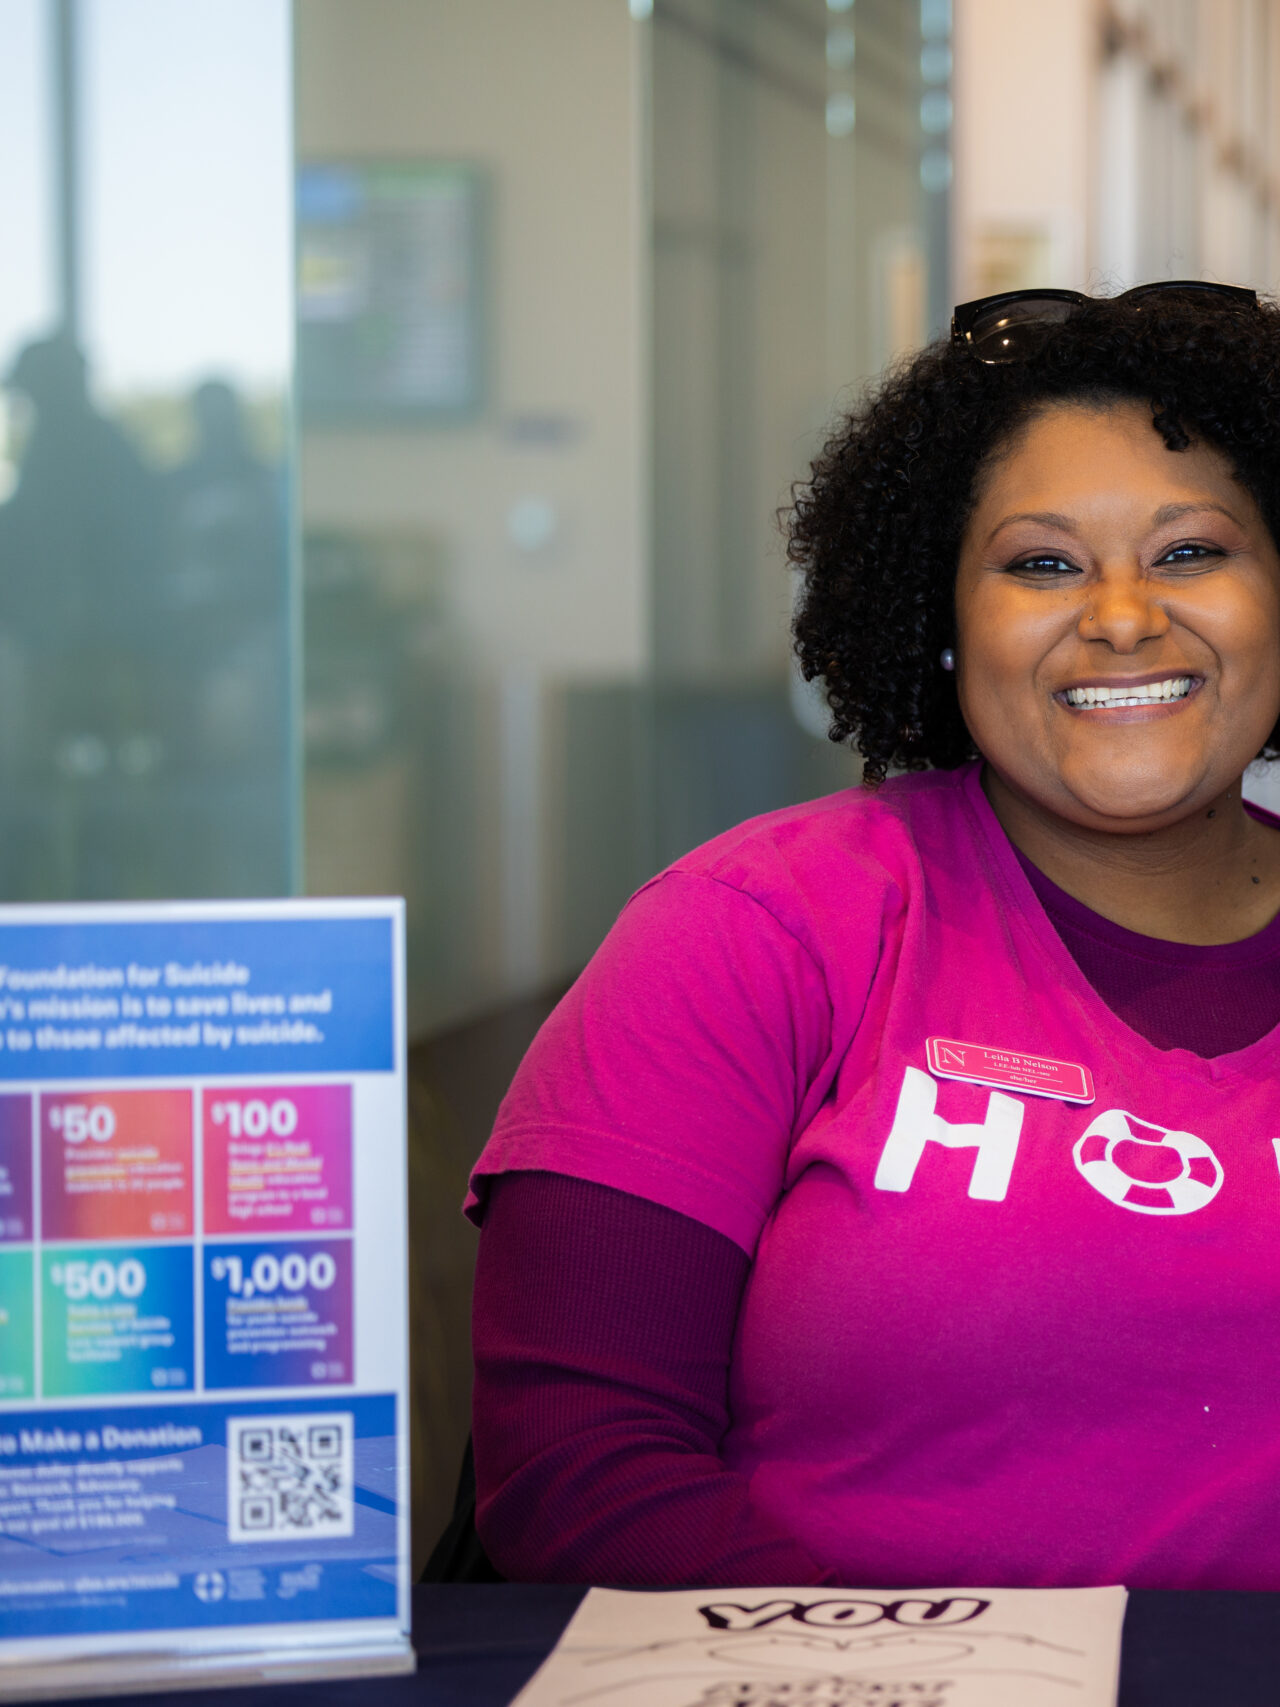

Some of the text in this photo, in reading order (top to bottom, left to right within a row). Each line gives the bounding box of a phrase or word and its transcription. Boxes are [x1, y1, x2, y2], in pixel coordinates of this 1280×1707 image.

[127, 962, 160, 988] for
[164, 961, 249, 987] Suicide
[28, 992, 119, 1019] mission
[121, 992, 144, 1019] is
[147, 992, 172, 1019] to
[175, 998, 229, 1016] save
[231, 991, 286, 1015] lives
[289, 989, 332, 1014] and
[6, 1018, 325, 1050] to those affected by suicide.
[941, 1047, 967, 1068] N
[983, 1051, 1059, 1073] Leila B Nelson
[1009, 1074, 1037, 1085] she/her
[49, 1104, 115, 1143] $50
[211, 1098, 298, 1138] $100
[51, 1258, 146, 1299] $500
[211, 1252, 336, 1298] $1,000
[19, 1427, 82, 1454] Make
[84, 1431, 100, 1451] a
[101, 1423, 202, 1450] Donation
[697, 1597, 993, 1630] YOU
